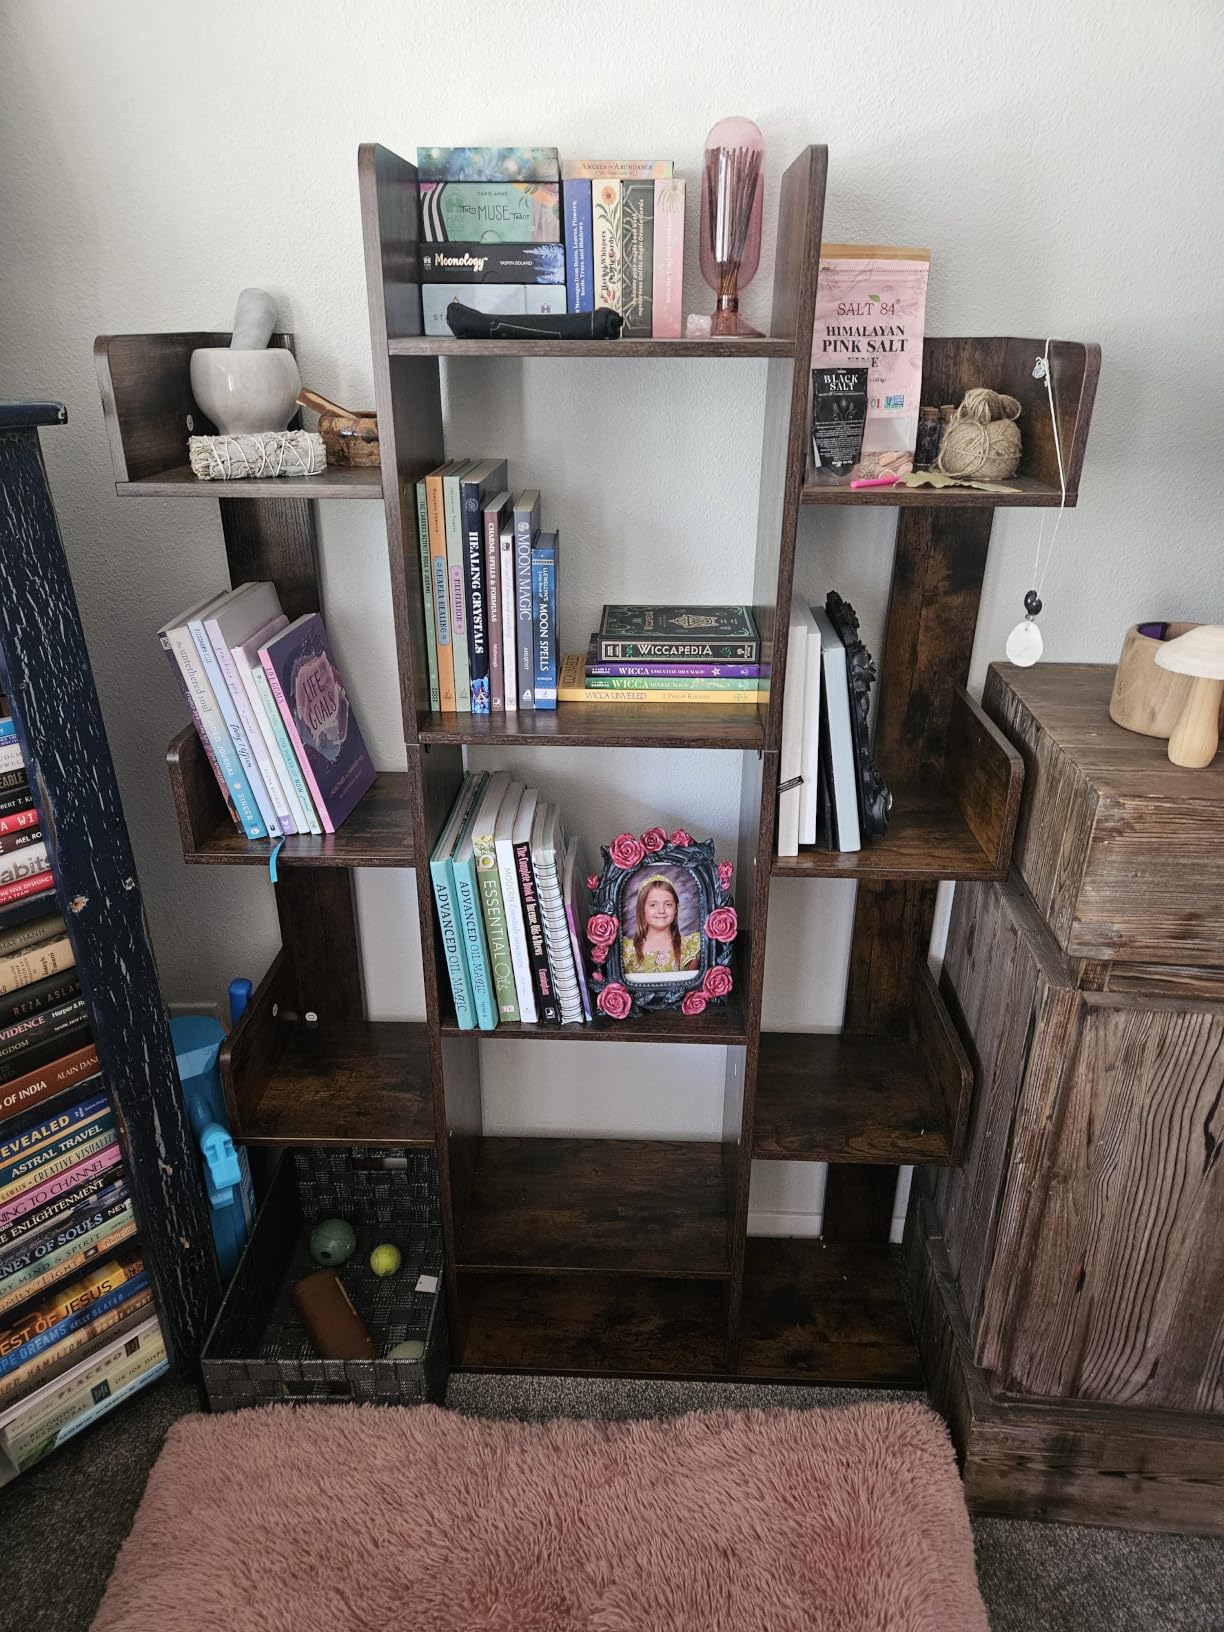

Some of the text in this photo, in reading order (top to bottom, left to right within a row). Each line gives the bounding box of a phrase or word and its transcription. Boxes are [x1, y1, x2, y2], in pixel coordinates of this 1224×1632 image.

[478, 205, 510, 221] MUSE
[599, 230, 607, 264] Whispers
[837, 302, 896, 316] SALT 84
[826, 325, 905, 337] HIMALAYAN
[822, 339, 909, 353] PINK SALT
[823, 374, 859, 384] BLACK
[829, 382, 855, 391] SALT
[487, 522, 495, 554] CHARMS,
[488, 556, 496, 578] SPELLS
[517, 534, 531, 620] MOON MAGIC
[436, 569, 446, 632] CHAKRA HEALING
[453, 578, 463, 620] MEDITATION
[468, 531, 484, 653] HEALING CRYSTALS
[489, 586, 497, 622] FORMULAS
[539, 603, 548, 637] MOON
[539, 640, 549, 671] SPELLS
[637, 644, 713, 655] WICCAPEDIA
[265, 667, 284, 704] LIFE GOALS
[612, 679, 649, 688] WICCA
[619, 667, 650, 675] WICCA
[302, 670, 325, 704] LIFE
[585, 692, 647, 700] WICCA UNVEILED
[179, 647, 204, 695] untethered
[197, 694, 211, 713] soul
[216, 743, 235, 777] JOURNAL
[308, 690, 338, 730] GOALS
[294, 778, 303, 793] NOW
[237, 792, 253, 821] SINGER
[14, 834, 30, 845] MEL
[516, 845, 527, 857] The
[517, 856, 532, 882] Complete
[9, 885, 21, 893] FIVE
[13, 889, 29, 897] TEAM
[502, 866, 515, 902] MODERN
[522, 881, 534, 896] Book
[459, 880, 477, 942] ADVANCED
[18, 927, 45, 943] HANH
[482, 879, 512, 991] ESSENTIAL Oils
[530, 924, 541, 935] Oils
[435, 882, 467, 1013] ADVANCED OIL MAGIC
[469, 943, 481, 961] OIL
[532, 939, 545, 956] Brews
[471, 962, 486, 995] MAGIC
[12, 997, 41, 1016] REZA
[50, 1004, 73, 1019] Harper
[54, 1065, 78, 1081] ALAIN
[1, 1079, 47, 1107] OF INDIA
[9, 1122, 103, 1177] ASTRAL TRAVEL
[27, 1159, 103, 1207] TO CHANNEL
[31, 1154, 75, 1183] CREATIVE
[9, 1177, 106, 1238] ENLIGHTENMENT
[32, 1238, 58, 1258] OF
[54, 1211, 104, 1246] SOULS
[17, 1261, 51, 1284] MIND
[53, 1255, 62, 1263] &
[64, 1231, 103, 1257] SPIRIT
[40, 1259, 80, 1285] LIGHT
[61, 1279, 114, 1316] JESUS
[68, 1293, 125, 1330] KELLY SLATER
[32, 1311, 61, 1334] OF
[17, 1322, 69, 1359] DREAMS
[24, 1337, 84, 1378] HAMILTON
[56, 1350, 122, 1400] PLACEBO
[29, 1404, 77, 1438] BECOMING
